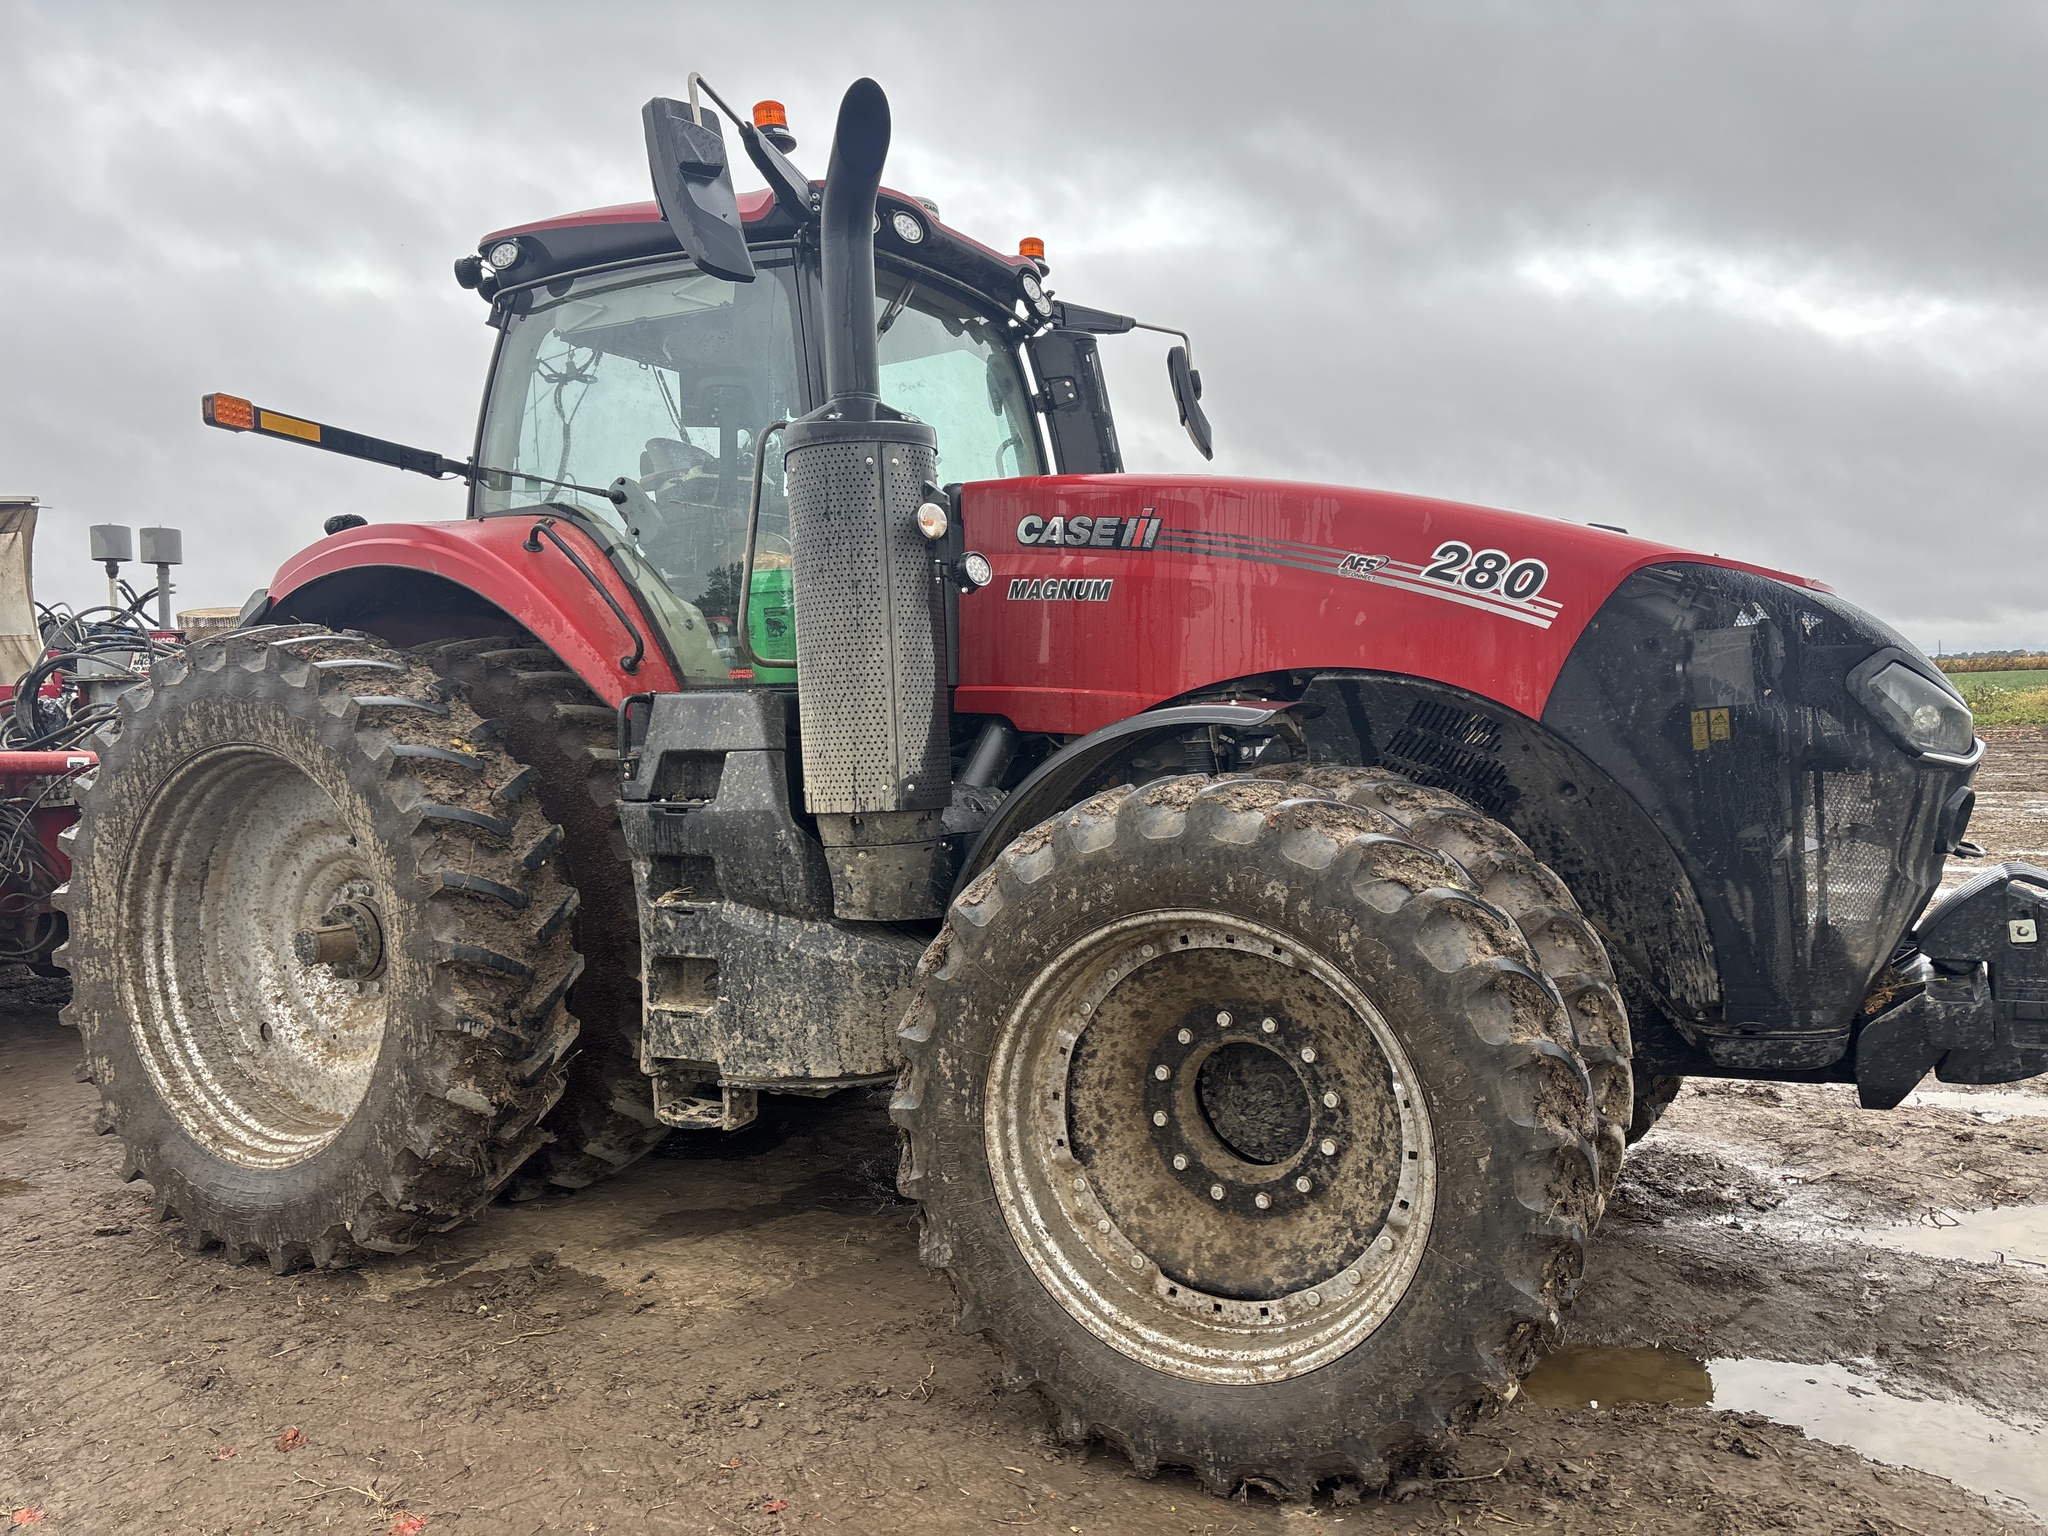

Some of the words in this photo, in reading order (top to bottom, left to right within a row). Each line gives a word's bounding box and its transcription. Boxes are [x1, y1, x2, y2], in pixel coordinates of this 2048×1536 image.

[1016, 514, 1121, 548] CASE
[1338, 553, 1379, 573] AFS
[1419, 540, 1549, 602] 280
[1007, 578, 1114, 602] MAGNUM
